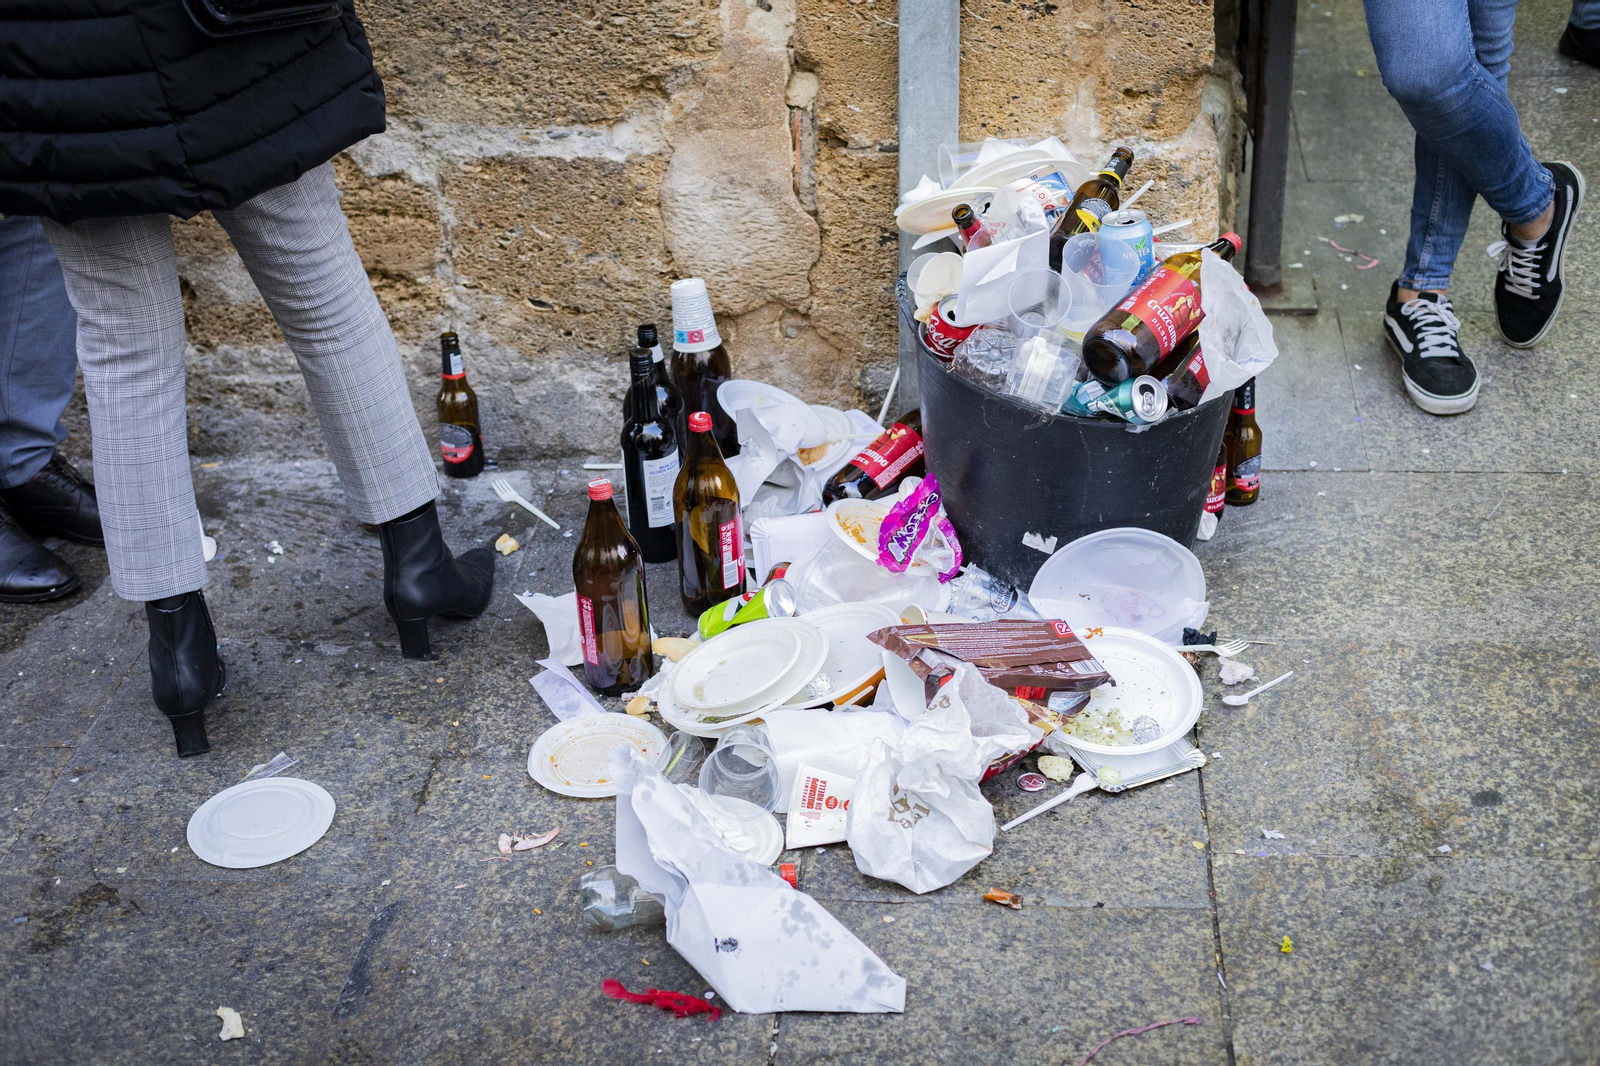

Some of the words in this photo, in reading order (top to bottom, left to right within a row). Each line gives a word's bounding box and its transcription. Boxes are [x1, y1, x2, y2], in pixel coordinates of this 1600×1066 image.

[1151, 317, 1169, 348] PILSEN
[800, 775, 811, 808] COMPROMISO
[806, 777, 819, 809] CRUZCAMPO
[816, 780, 827, 802] HUELLA
